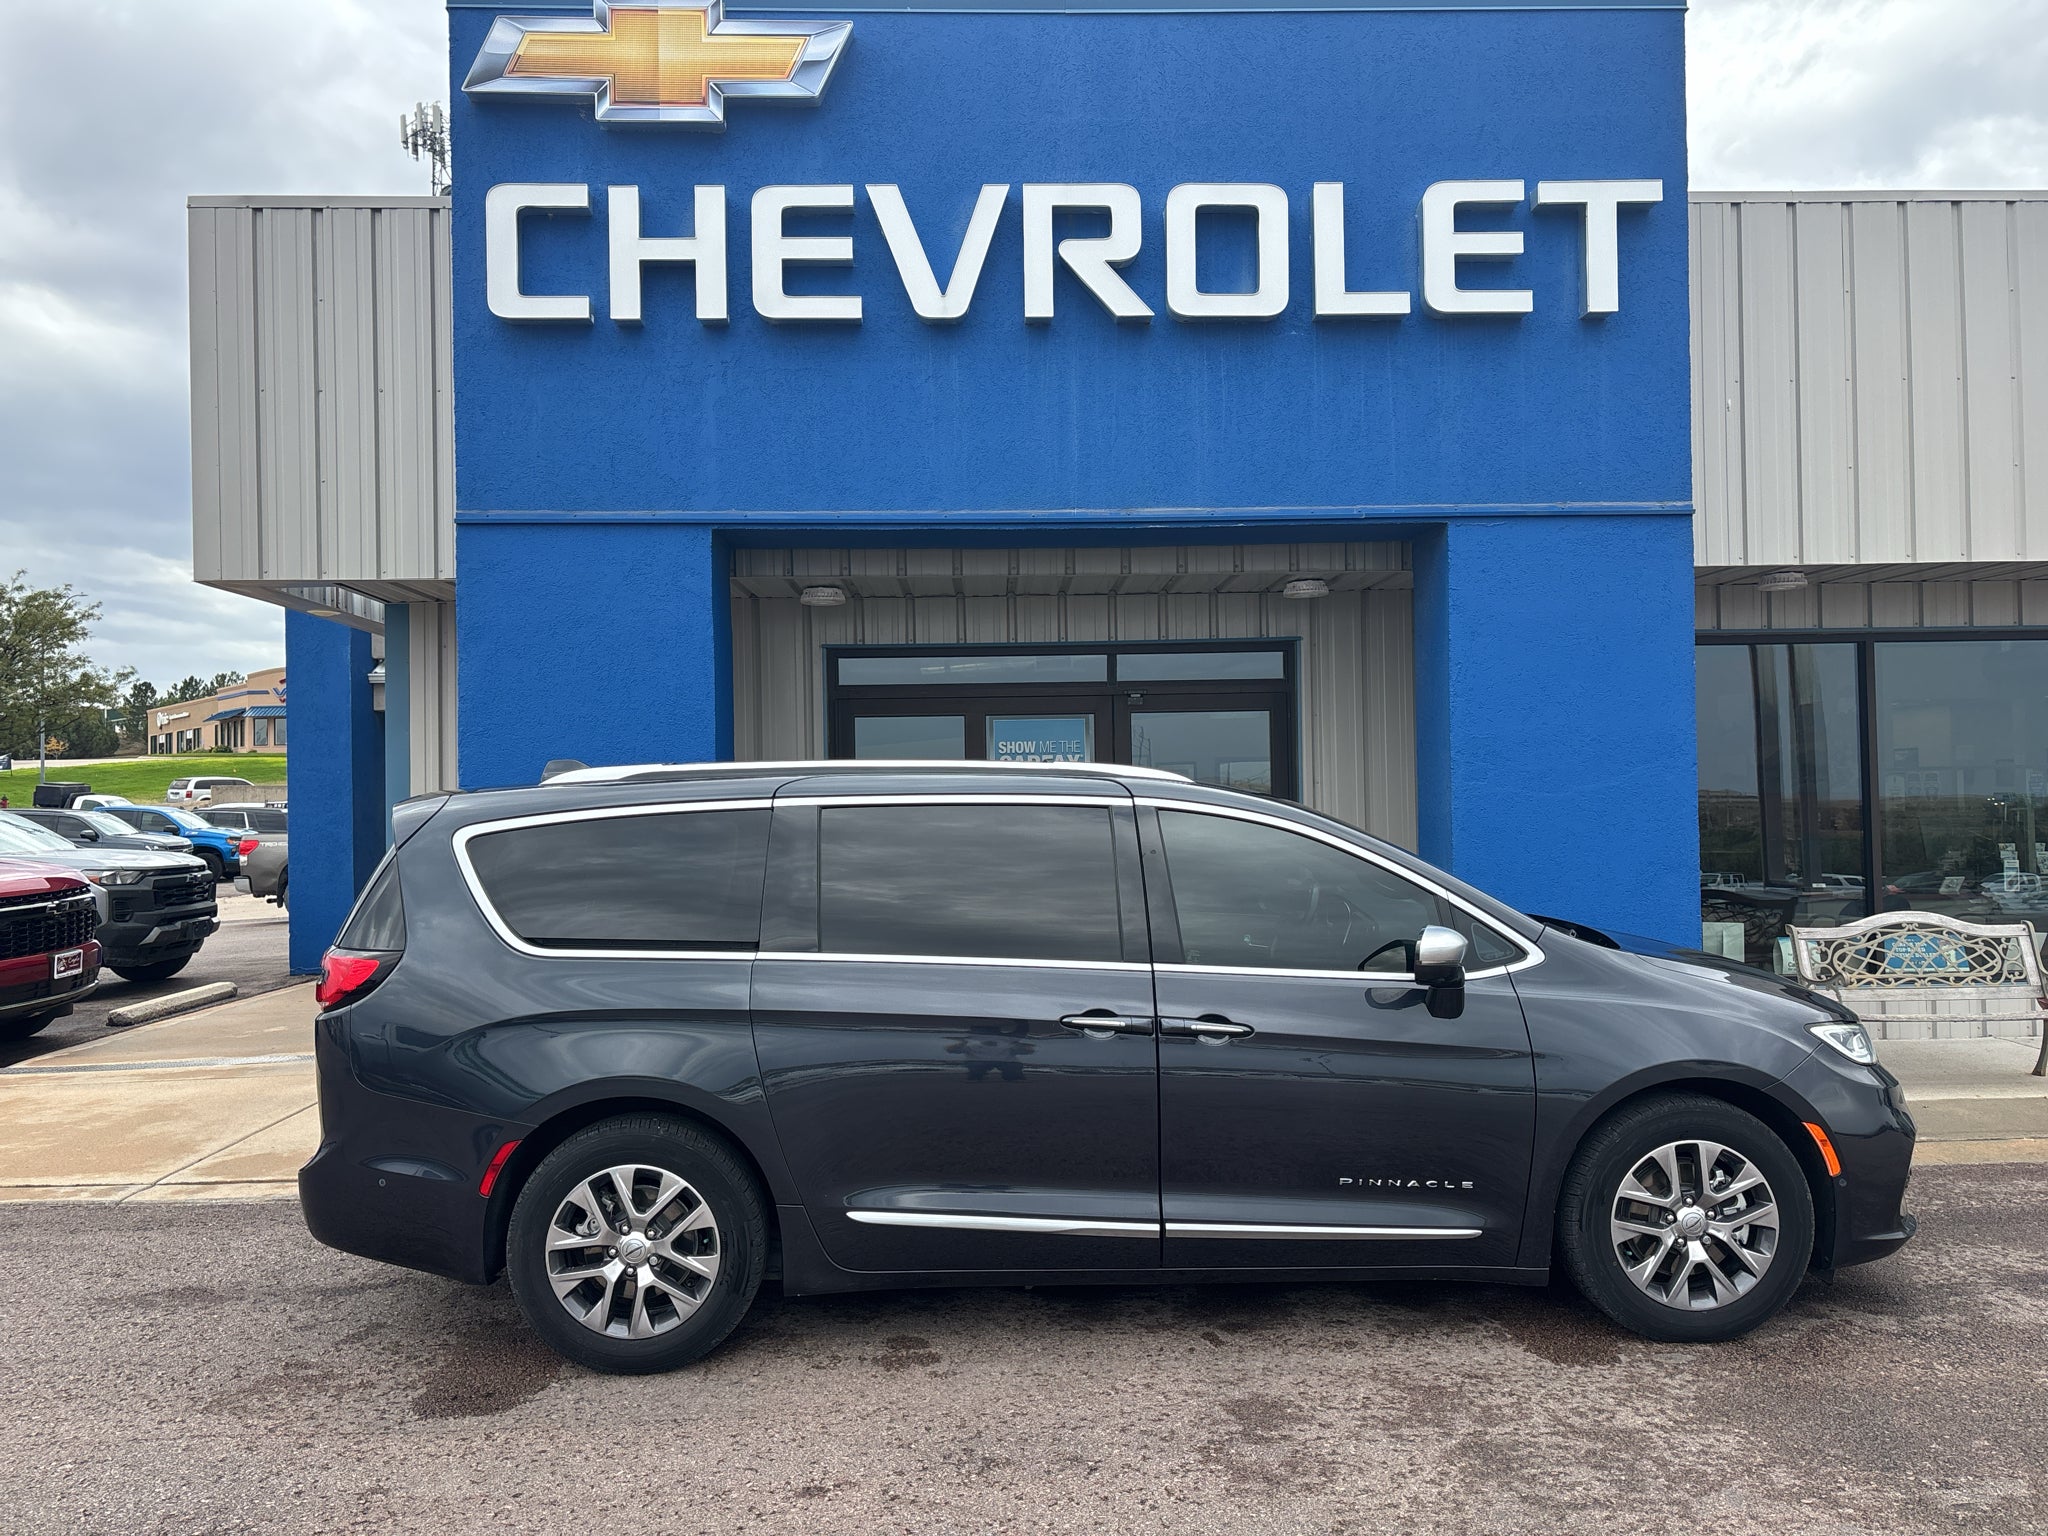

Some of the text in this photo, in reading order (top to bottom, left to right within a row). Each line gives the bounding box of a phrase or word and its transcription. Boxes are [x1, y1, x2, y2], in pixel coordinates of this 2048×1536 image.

[485, 179, 1664, 322] CHEVROLET
[998, 740, 1081, 754] SHOW ME THE
[1339, 1177, 1474, 1189] PINNACLE
